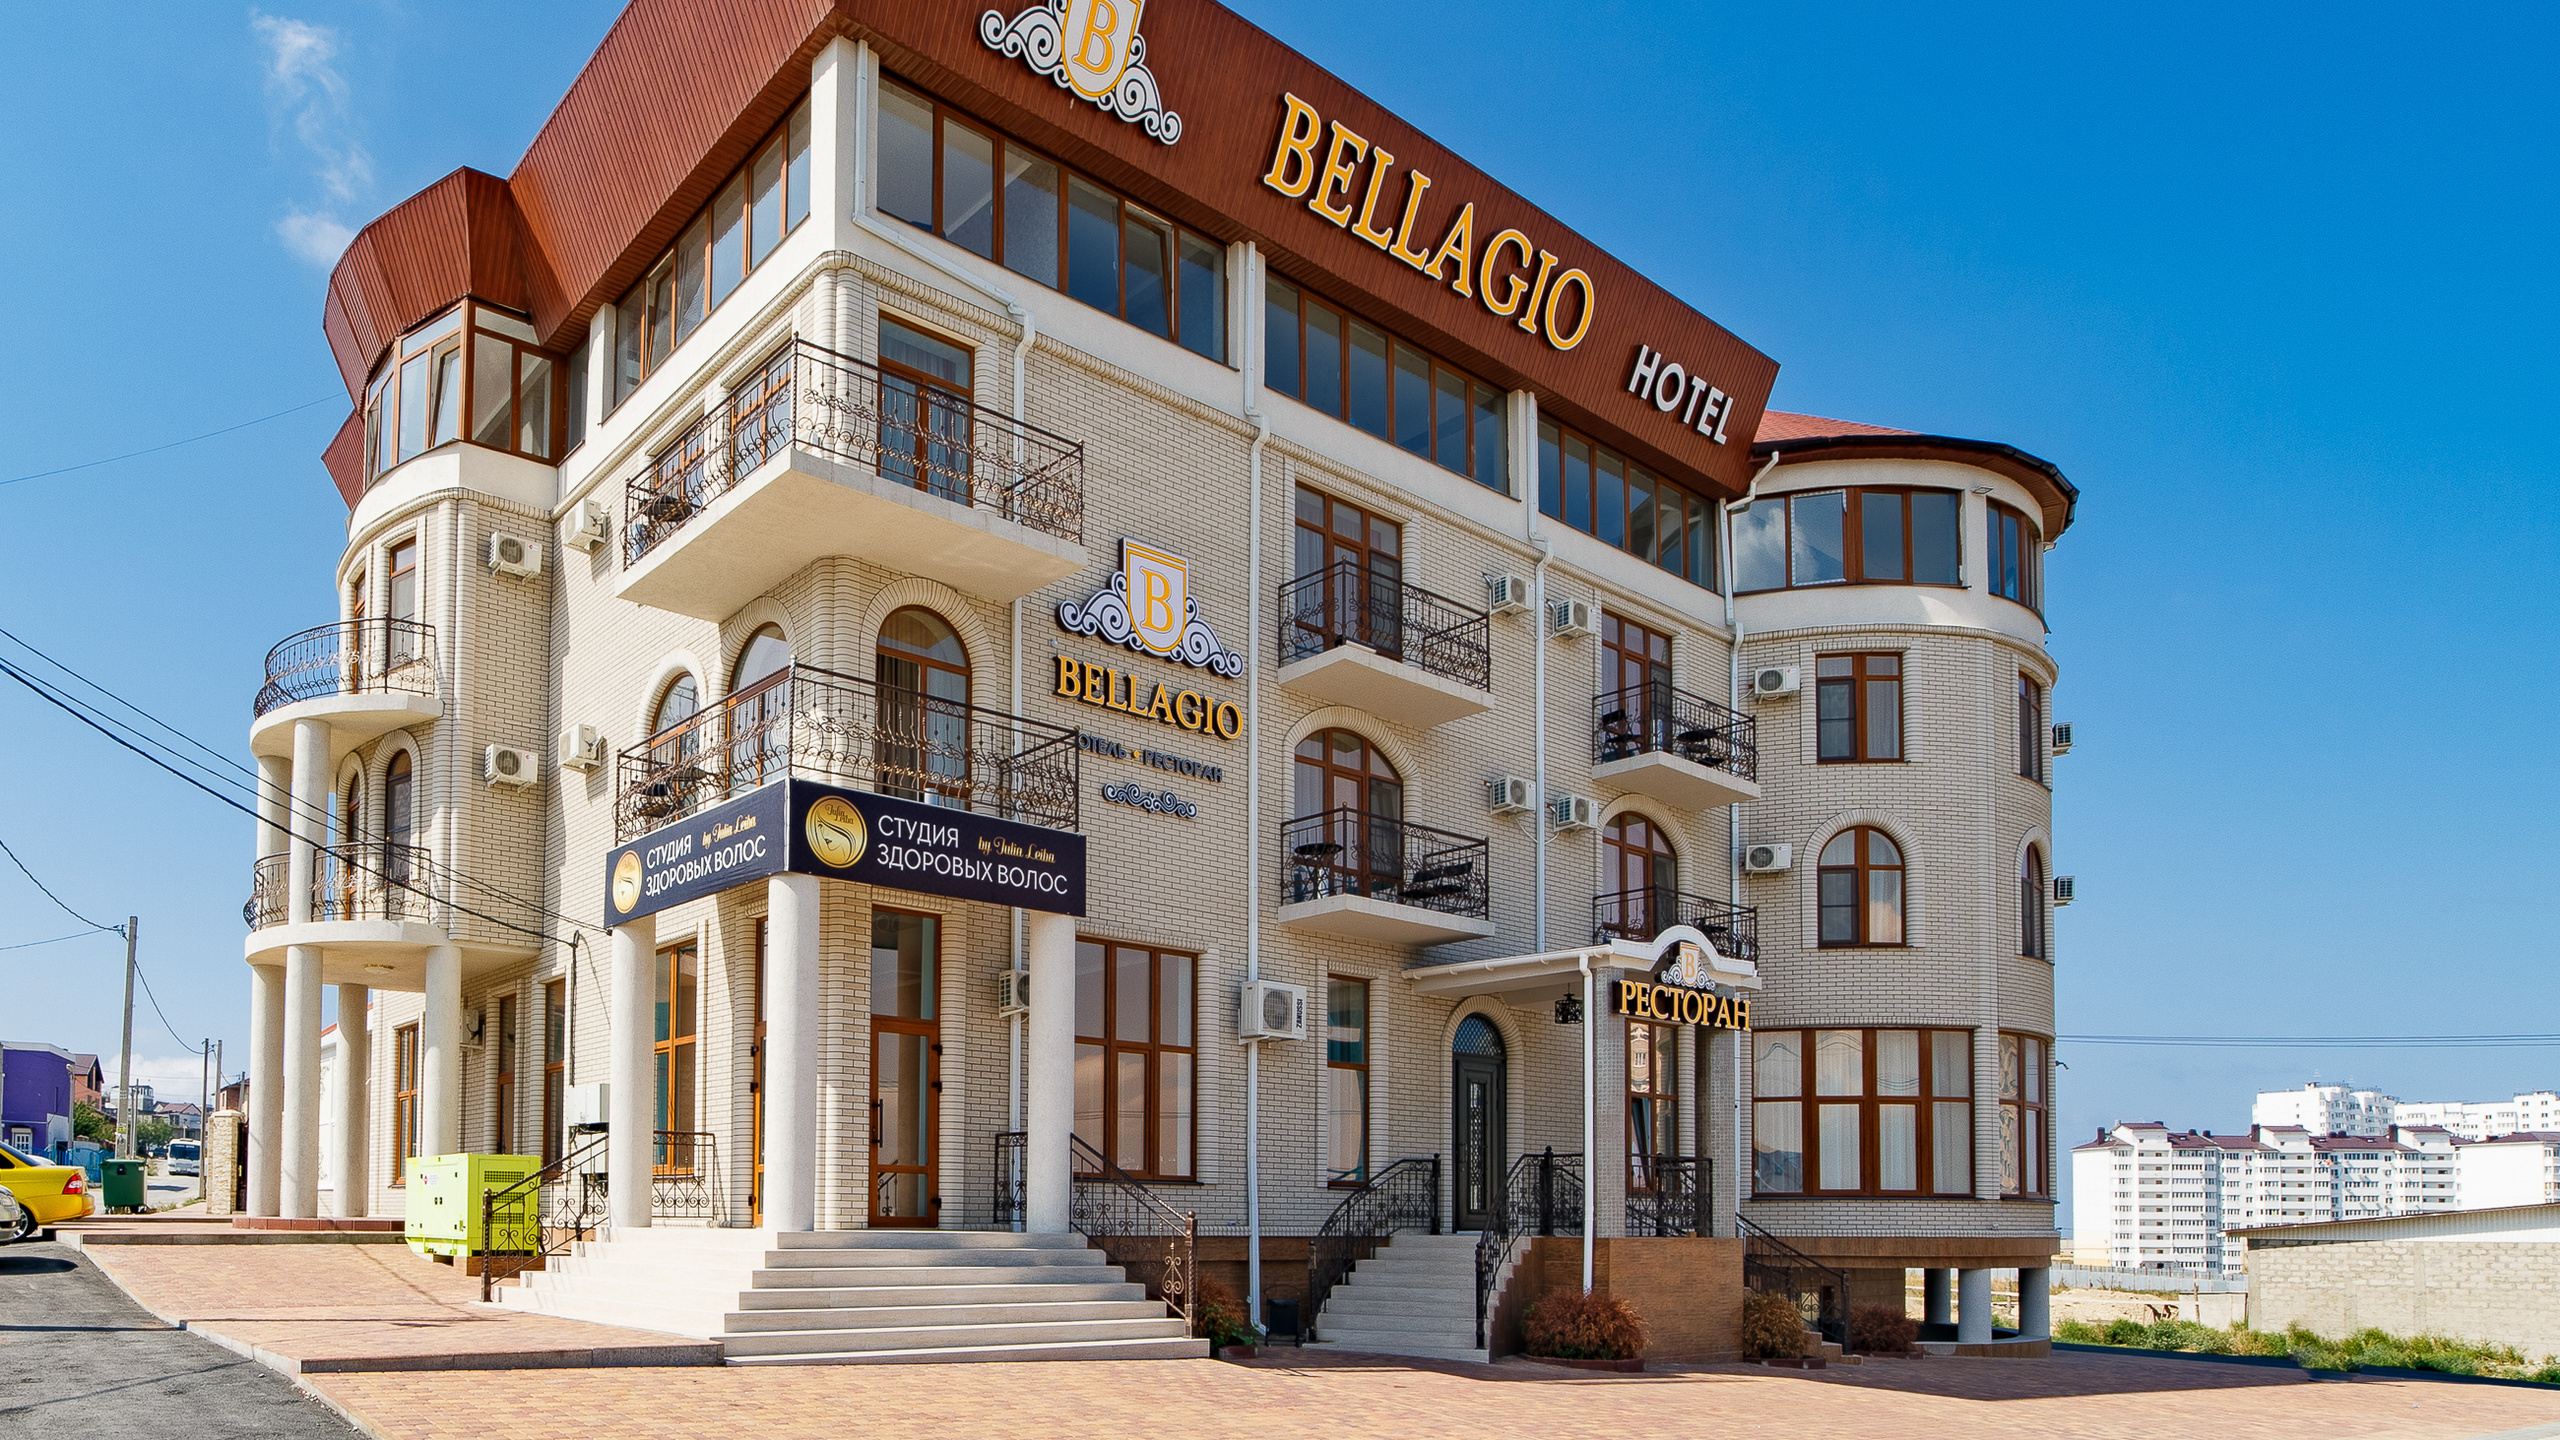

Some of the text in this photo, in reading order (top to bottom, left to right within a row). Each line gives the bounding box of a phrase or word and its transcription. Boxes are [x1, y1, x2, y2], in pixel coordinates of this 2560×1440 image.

[1072, 0, 1119, 75] B
[1264, 92, 1594, 350] BELLAGIO
[1628, 344, 1733, 445] HOTEL
[1140, 567, 1173, 633] B
[1057, 654, 1243, 739] BELLAGIO
[1078, 733, 1222, 782] ОТЕЛЬ РЕСТОРАН
[646, 834, 692, 869] СТУДИЯ
[878, 815, 959, 848] СТУДИЯ
[978, 836, 992, 855] by
[993, 836, 1024, 857] Julia
[645, 834, 767, 898] ЗДОРОВЫХ ВОЛОС
[877, 843, 1068, 895] ЗДОРОВЫХ ВОЛОС
[1619, 979, 1751, 1031] РЕСТОРАН
